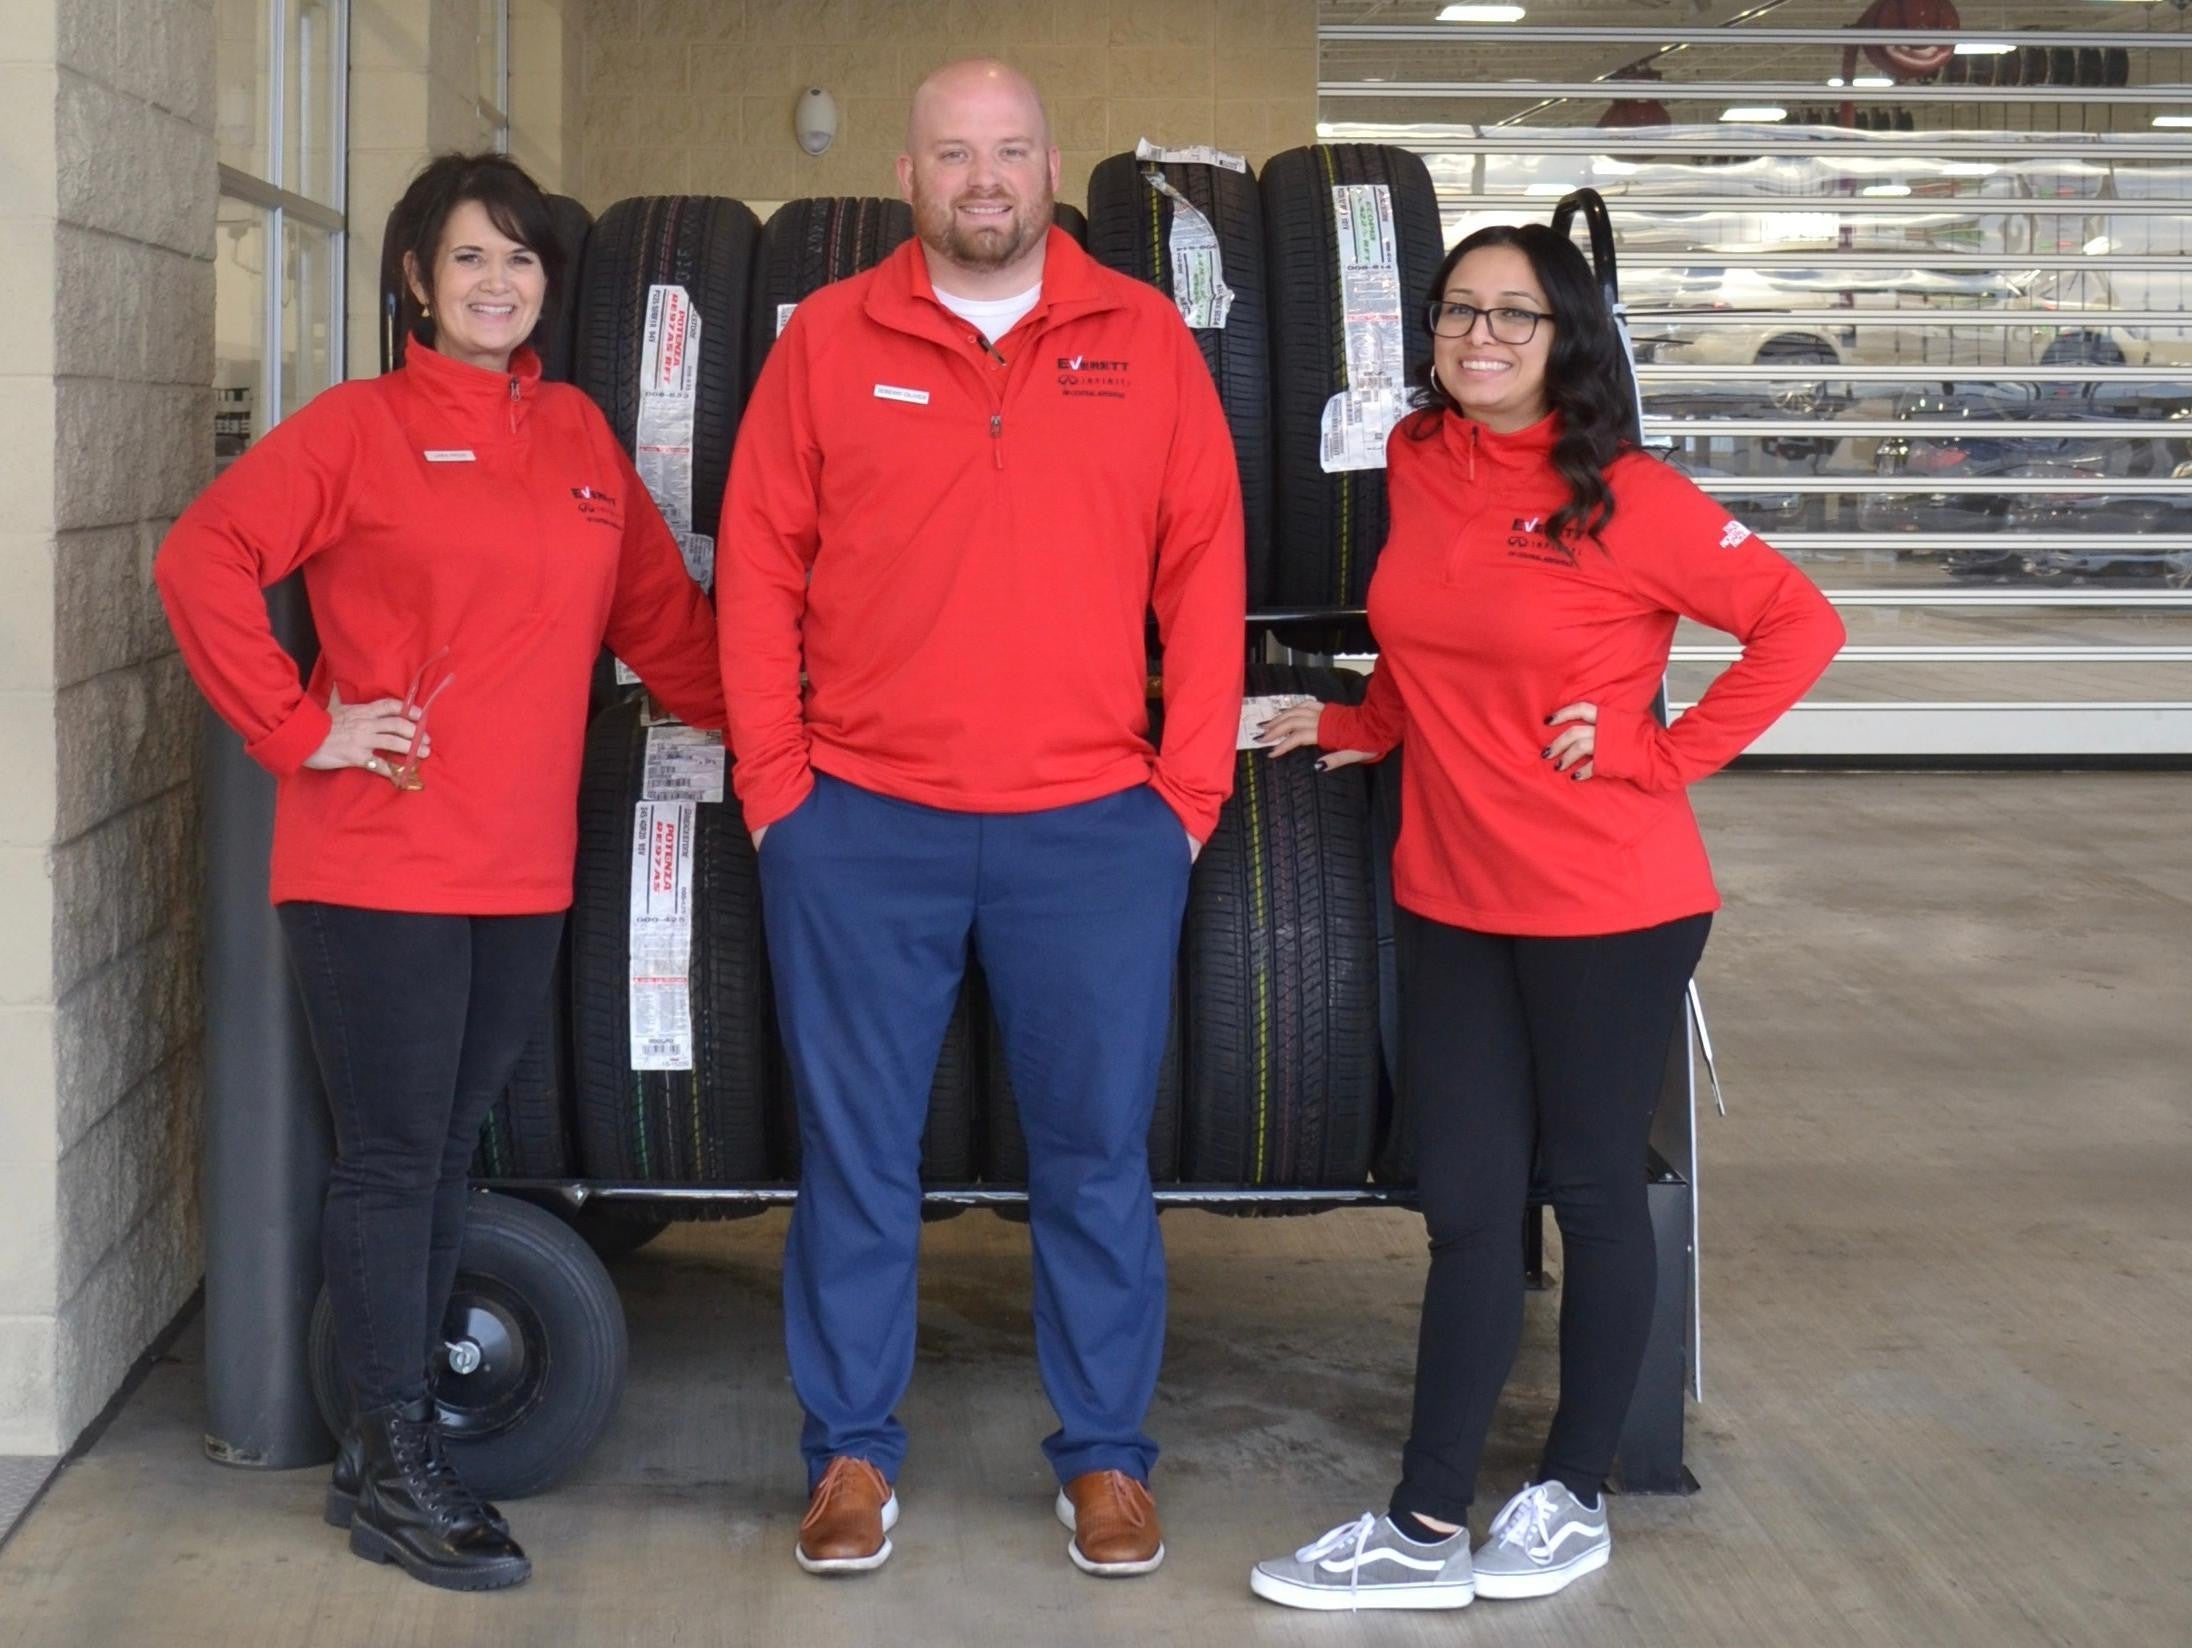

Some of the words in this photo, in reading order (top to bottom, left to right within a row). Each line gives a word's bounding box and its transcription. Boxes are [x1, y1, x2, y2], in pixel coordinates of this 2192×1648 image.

[673, 310, 685, 366] POTENZA
[1057, 355, 1128, 371] EVERETT
[663, 822, 675, 891] POTENZA
